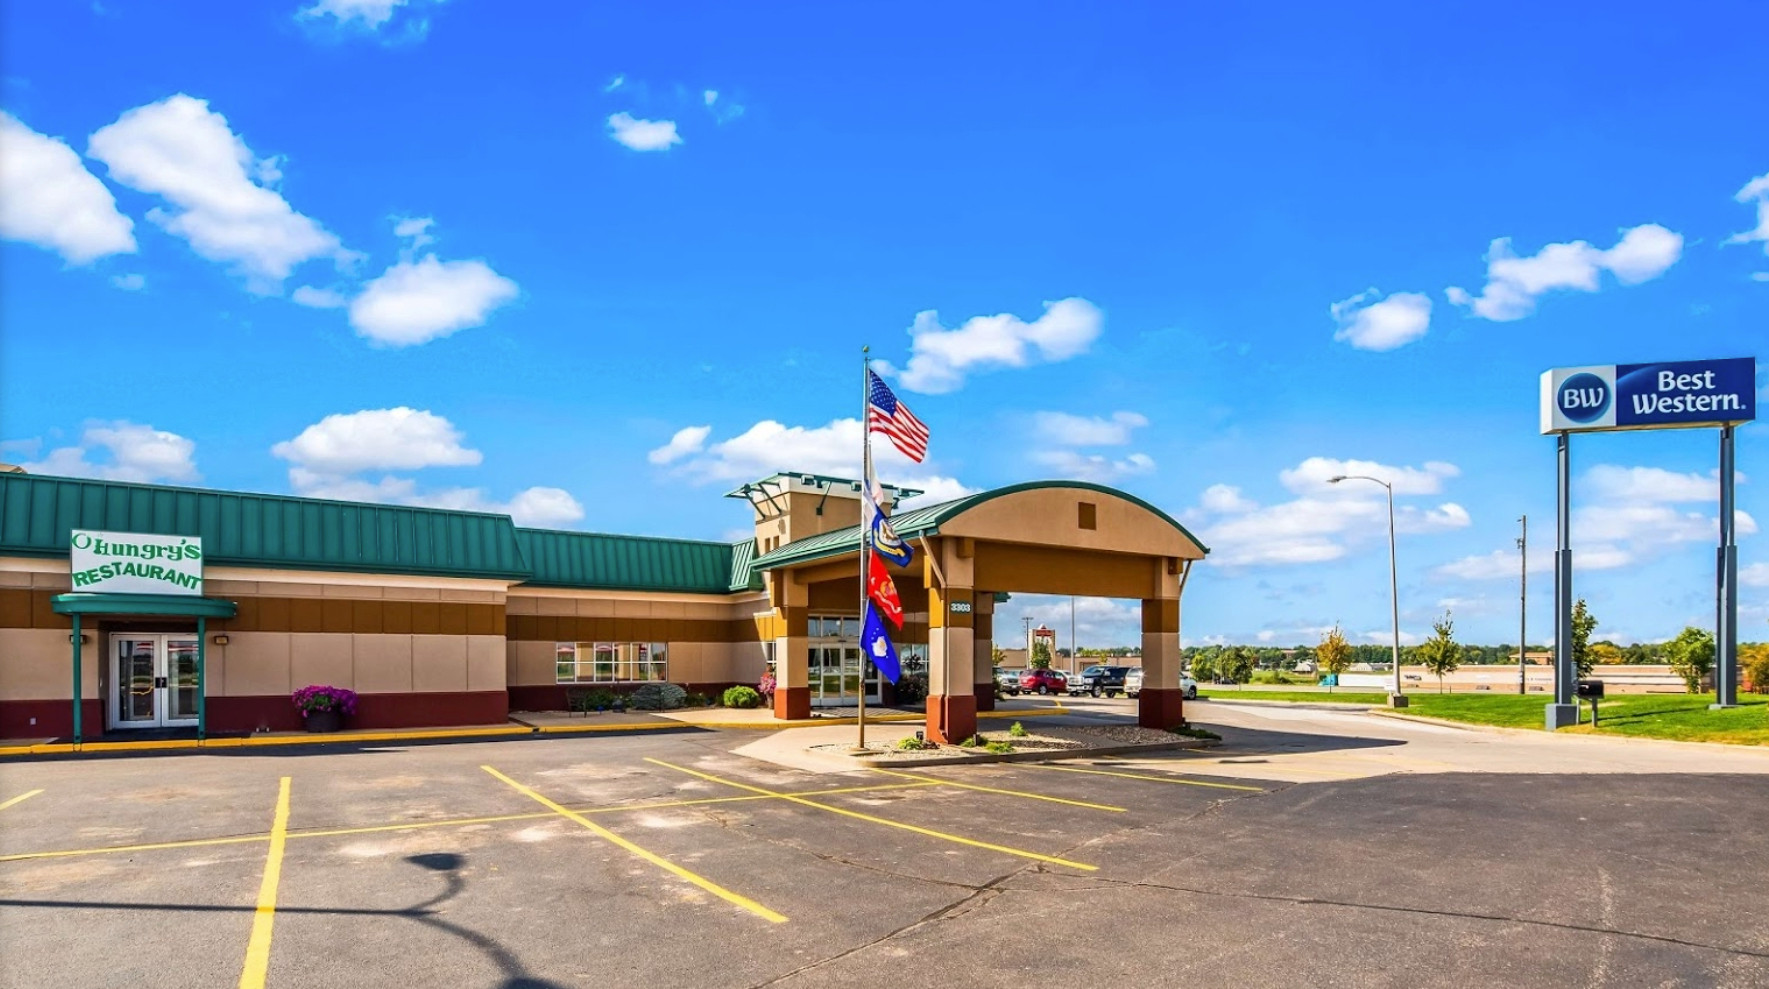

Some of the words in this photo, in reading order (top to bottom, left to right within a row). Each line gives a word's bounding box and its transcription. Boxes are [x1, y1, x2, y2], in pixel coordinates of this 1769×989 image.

[1658, 370, 1715, 391] Best
[1564, 387, 1604, 409] BW
[72, 562, 202, 590] RESTAURANT
[950, 602, 971, 612] 3303
